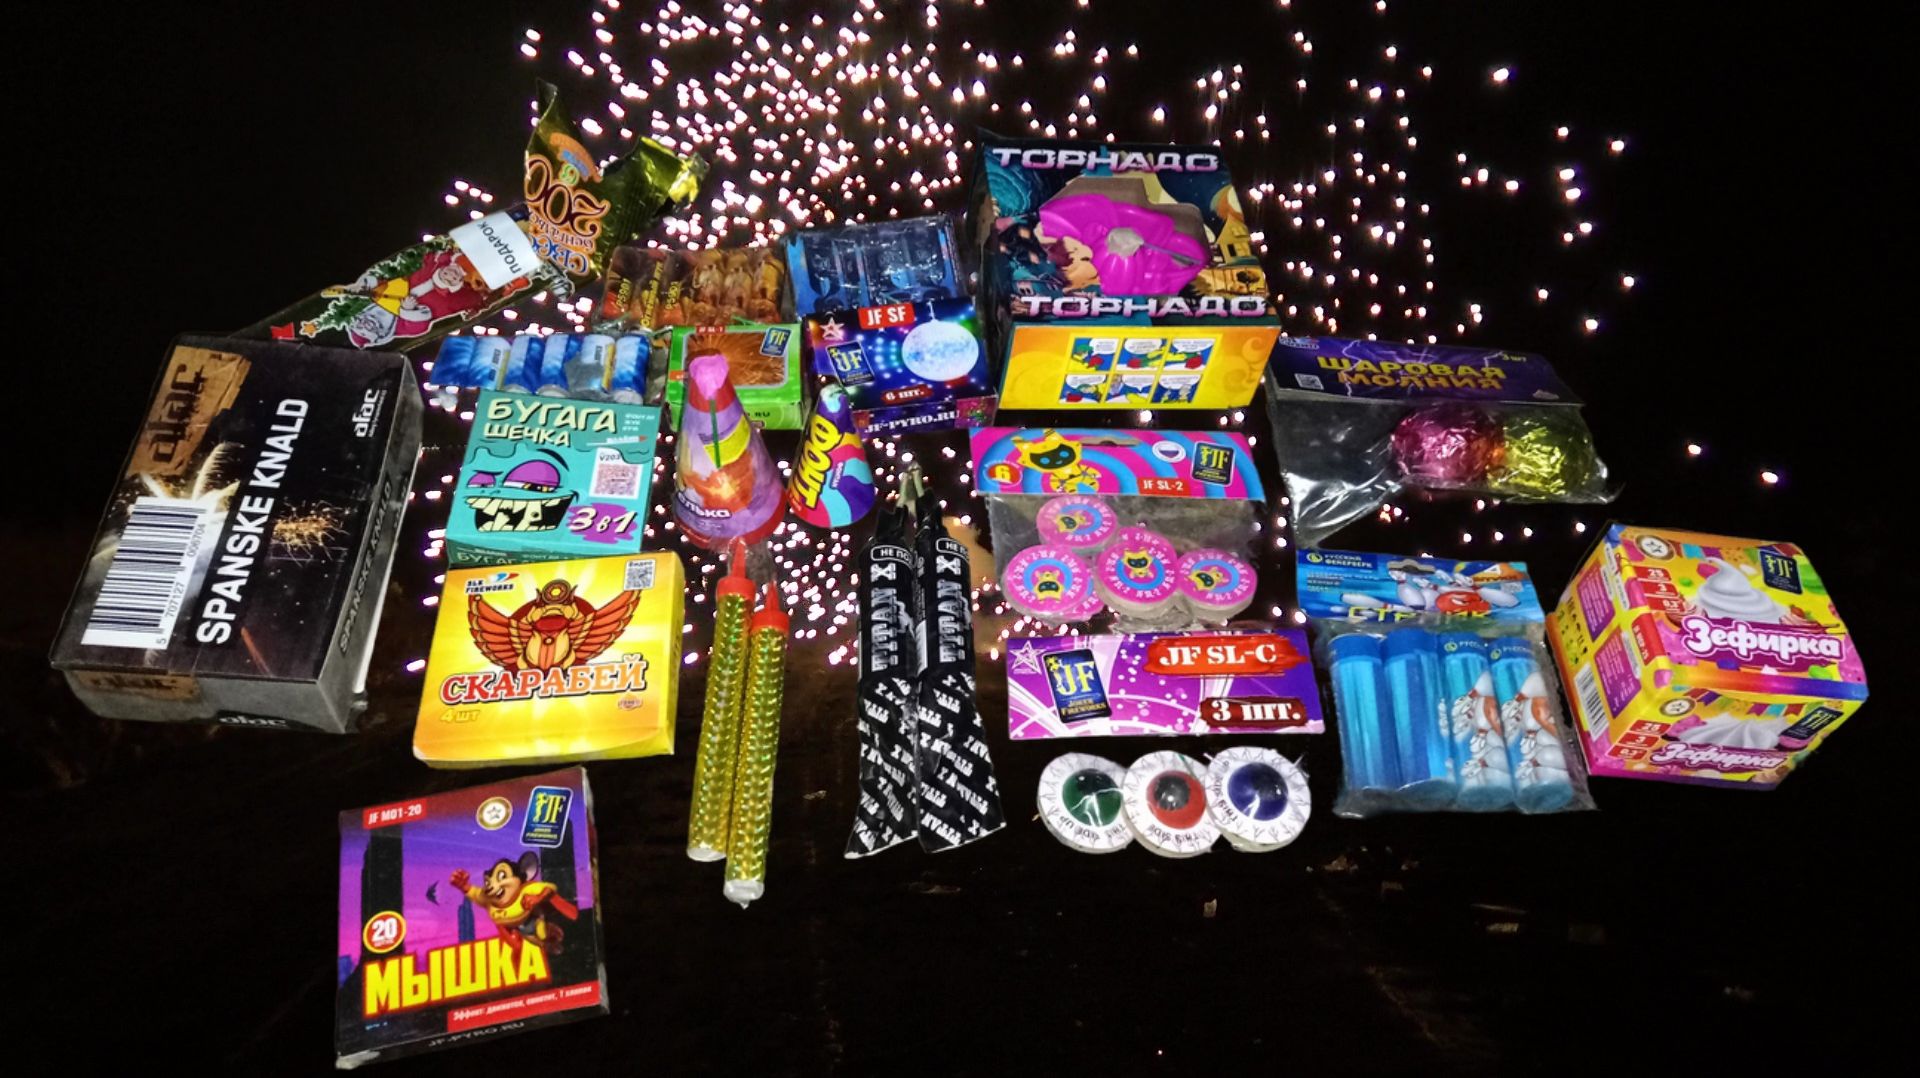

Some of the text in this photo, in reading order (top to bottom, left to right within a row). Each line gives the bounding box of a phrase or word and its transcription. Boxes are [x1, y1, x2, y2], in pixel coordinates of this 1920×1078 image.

[992, 148, 1219, 172] ТОРНАДО
[476, 220, 523, 274] ПОДАРОК
[867, 305, 908, 326] JF SF
[1020, 295, 1268, 317] ТОРНАДО
[1317, 356, 1507, 379] ШАРОВАЯ
[1338, 371, 1502, 390] МОЛНИЯ
[885, 392, 895, 401] 6
[354, 387, 380, 438] afac
[488, 398, 617, 433] БУГАГА
[483, 422, 570, 447] ШЕЧКА
[995, 465, 1007, 482] 6
[1143, 478, 1184, 491] JF SL-2
[195, 398, 309, 645] SPANSKE KNALD
[569, 507, 598, 530] 3
[613, 511, 638, 533] 1
[880, 548, 893, 557] НЕ
[165, 583, 185, 618] 707127
[465, 584, 514, 594] FIREWORKS
[870, 562, 899, 673] TITAN X
[936, 555, 966, 663] TITAN X
[155, 637, 167, 646] 5
[1687, 618, 1841, 660] Зефирка
[1159, 644, 1277, 667] JF SL-C
[440, 654, 648, 704] СКАРАБЕЙ
[1057, 661, 1096, 696] JF
[440, 708, 454, 723] 4
[1060, 702, 1108, 717] FIREWORKS
[1211, 701, 1231, 720] 3
[1653, 743, 1781, 769] Зефирка
[368, 812, 378, 824] JF
[372, 917, 397, 941] 20
[365, 938, 548, 1016] МЫШКА
